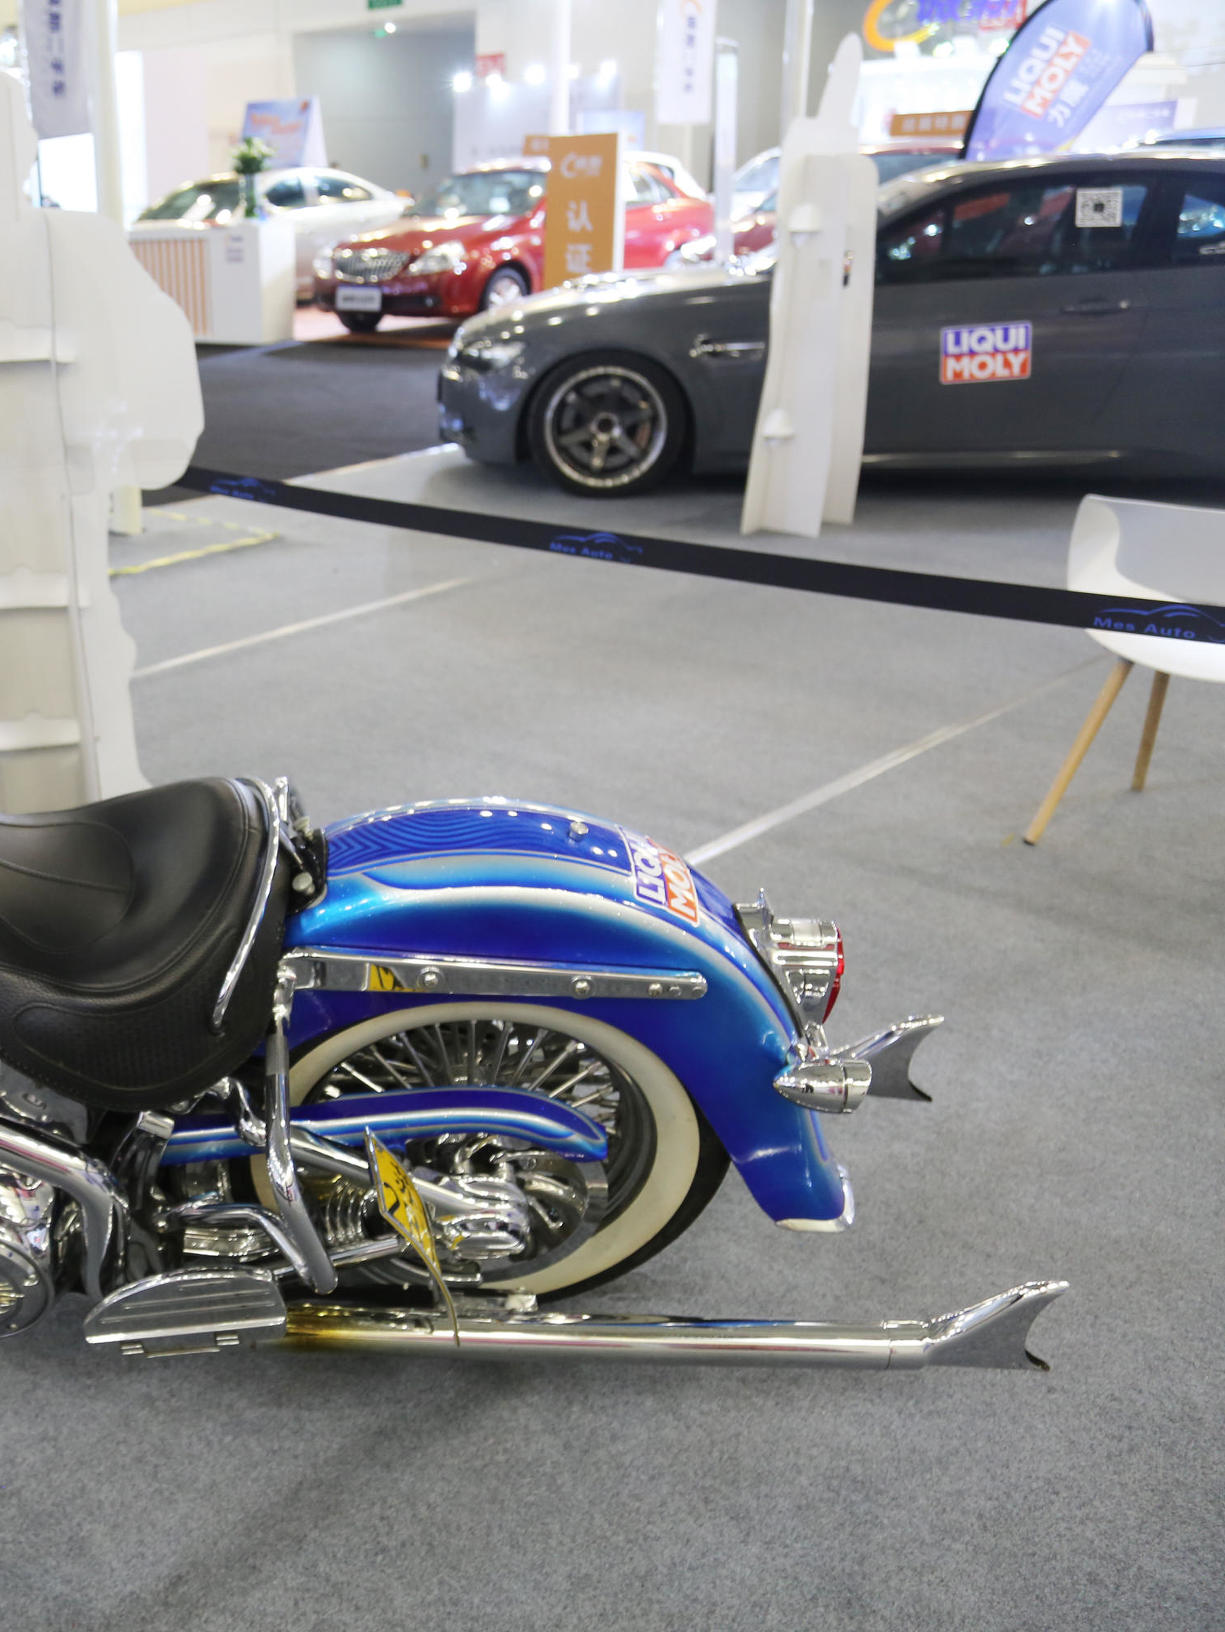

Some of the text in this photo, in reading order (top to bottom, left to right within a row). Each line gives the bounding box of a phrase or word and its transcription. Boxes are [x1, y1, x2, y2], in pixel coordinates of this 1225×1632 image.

[1003, 25, 1066, 107] LIQUI
[1026, 33, 1088, 115] MOLY
[946, 325, 1026, 355] LIQUI
[945, 352, 1026, 381] MOLY
[1093, 616, 1196, 639] Mes Auto
